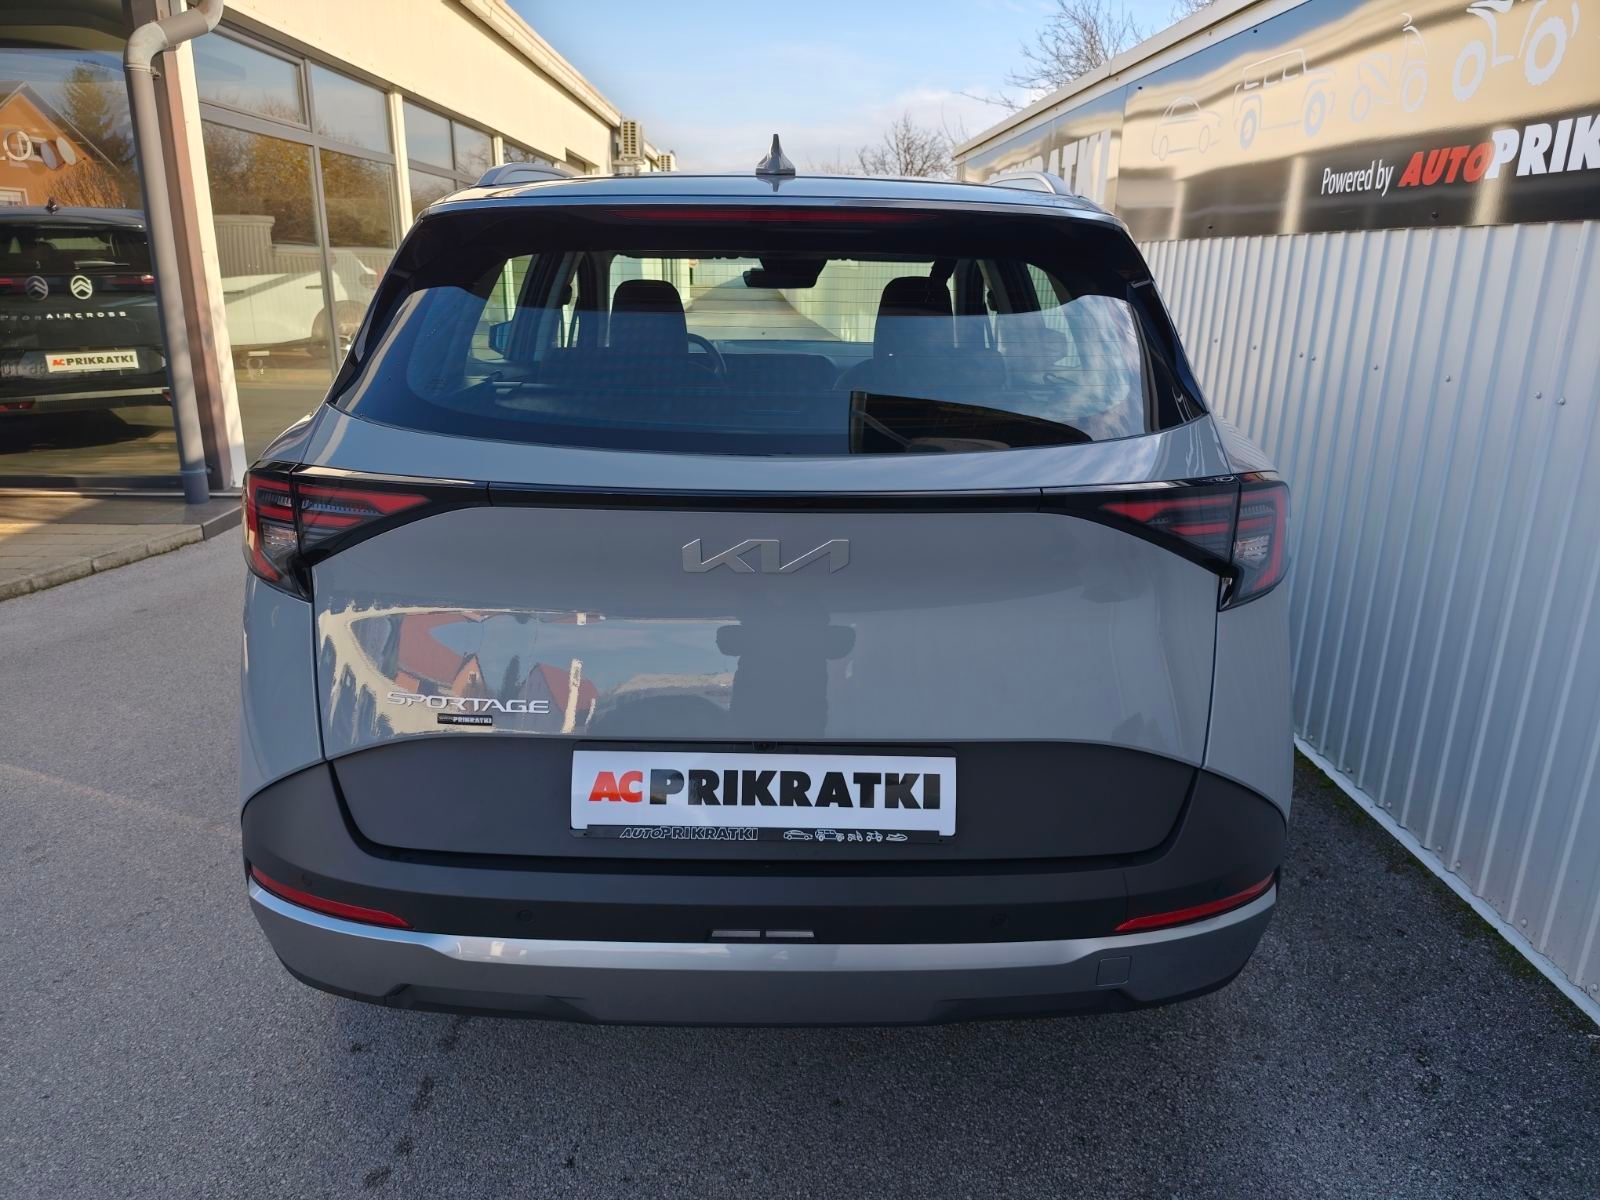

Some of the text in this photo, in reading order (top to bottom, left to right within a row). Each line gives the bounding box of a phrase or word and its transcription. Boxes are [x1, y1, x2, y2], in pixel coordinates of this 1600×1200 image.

[1321, 161, 1376, 195] Powered
[1374, 158, 1394, 197] by
[46, 311, 127, 319] AIRCROSS
[386, 691, 550, 714] SPORTAGE
